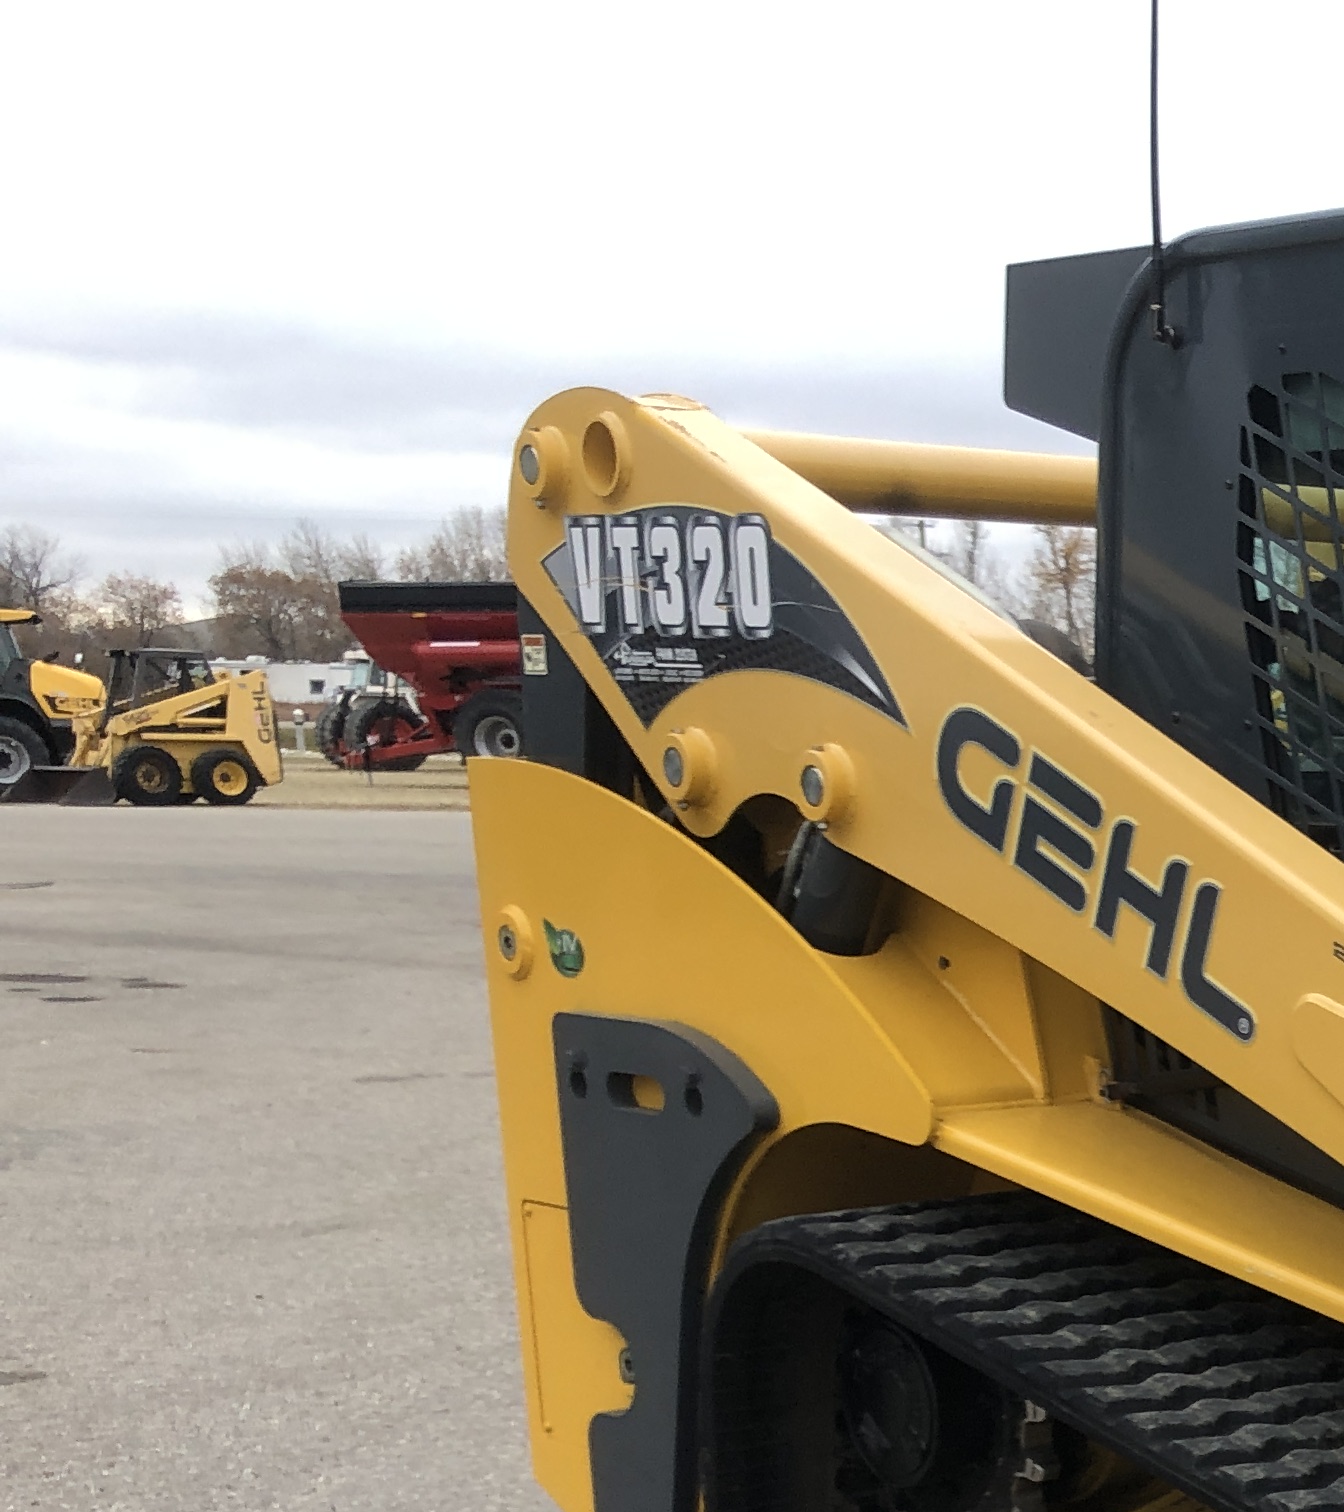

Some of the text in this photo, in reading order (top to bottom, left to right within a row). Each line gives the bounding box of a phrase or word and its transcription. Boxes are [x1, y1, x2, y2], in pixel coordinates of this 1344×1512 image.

[565, 512, 774, 641] VT320
[250, 681, 272, 744] GEHL
[934, 703, 1257, 1044] GEHL
